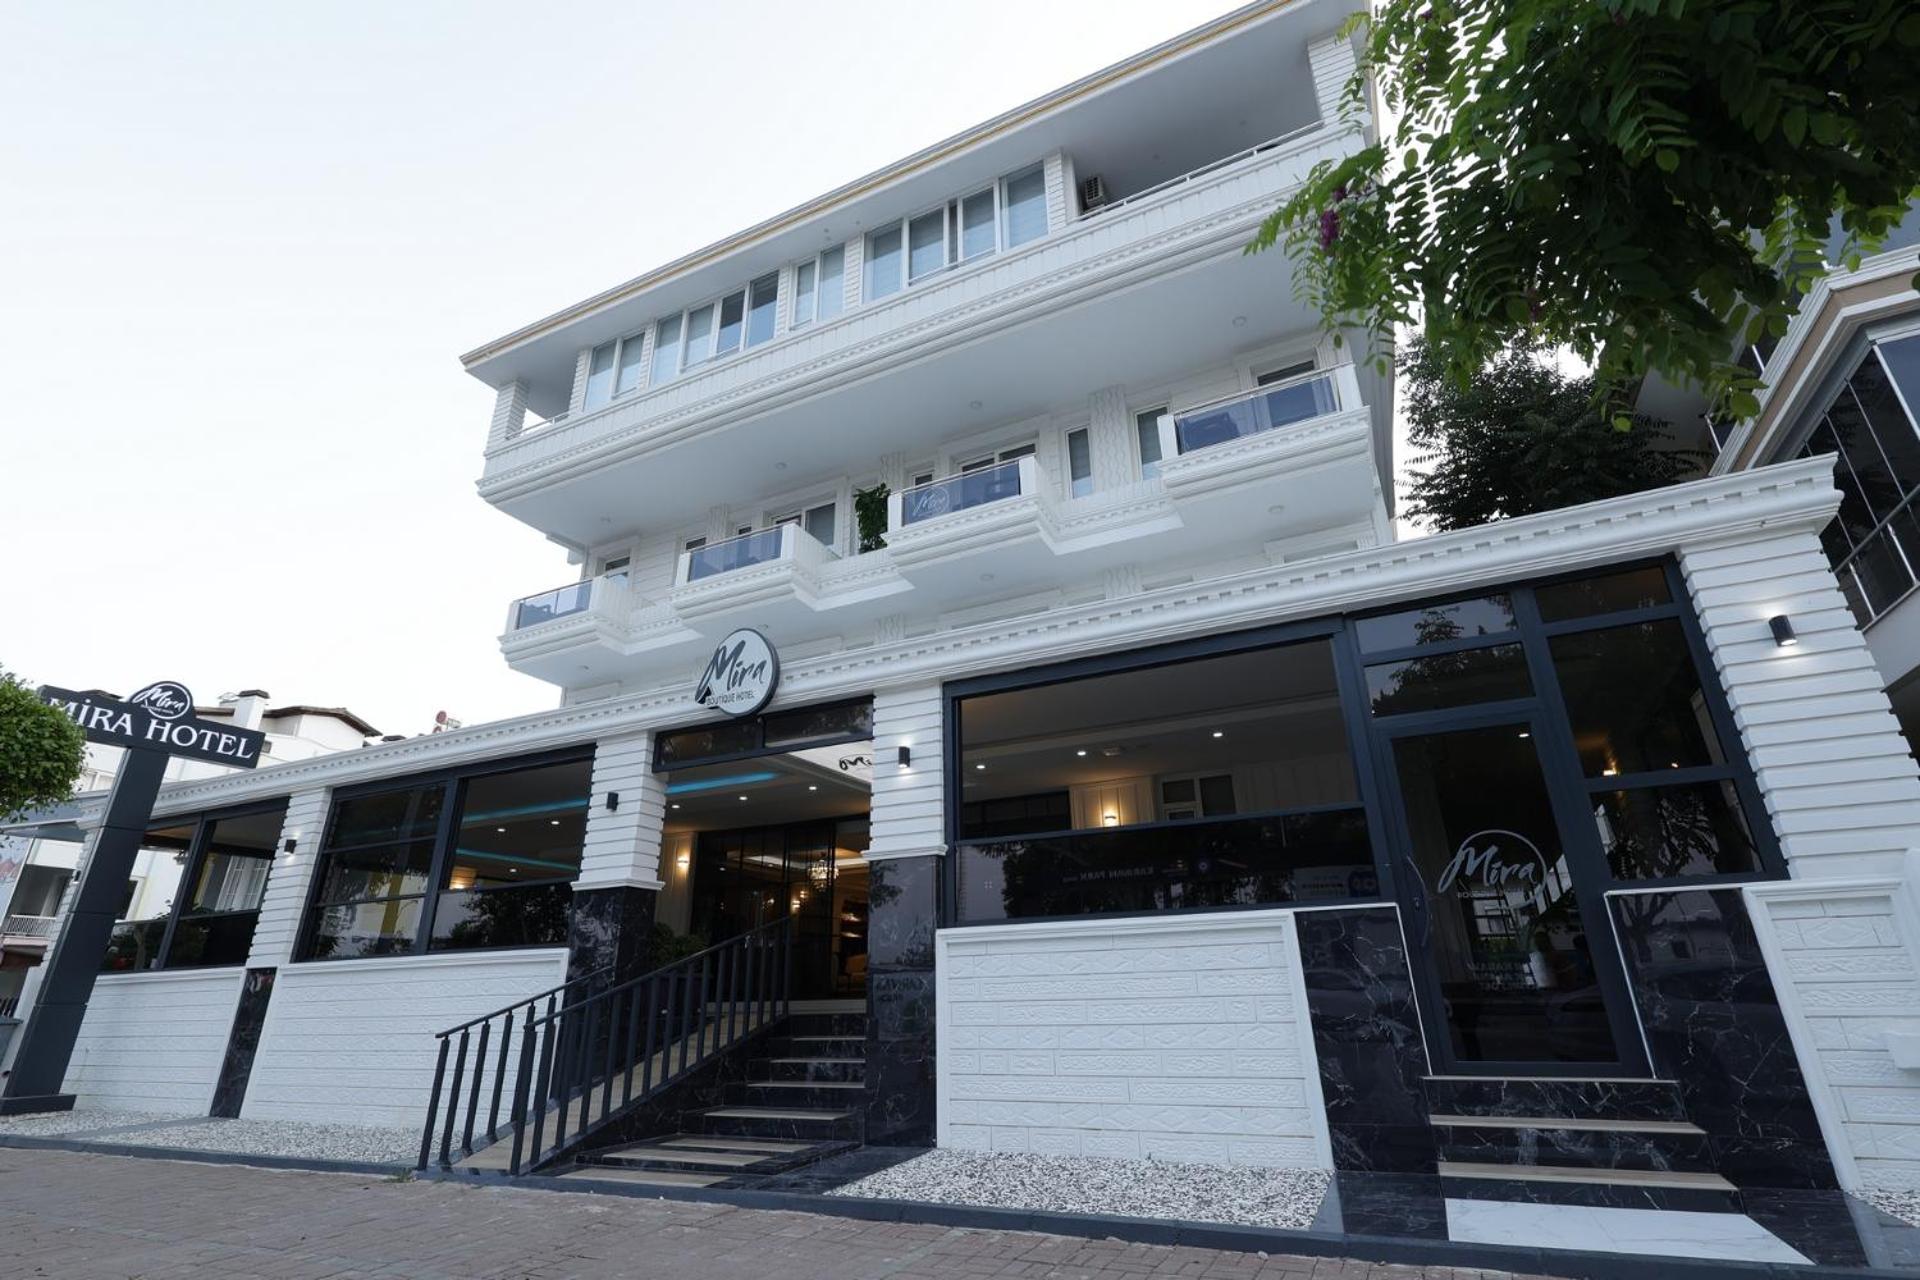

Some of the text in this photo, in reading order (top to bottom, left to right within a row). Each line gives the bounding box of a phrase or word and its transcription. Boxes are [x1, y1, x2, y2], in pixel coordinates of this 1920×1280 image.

[695, 640, 767, 704] Mira
[736, 690, 755, 702] HOTEL
[145, 718, 254, 759] HOTEL
[1437, 844, 1538, 894] Mira
